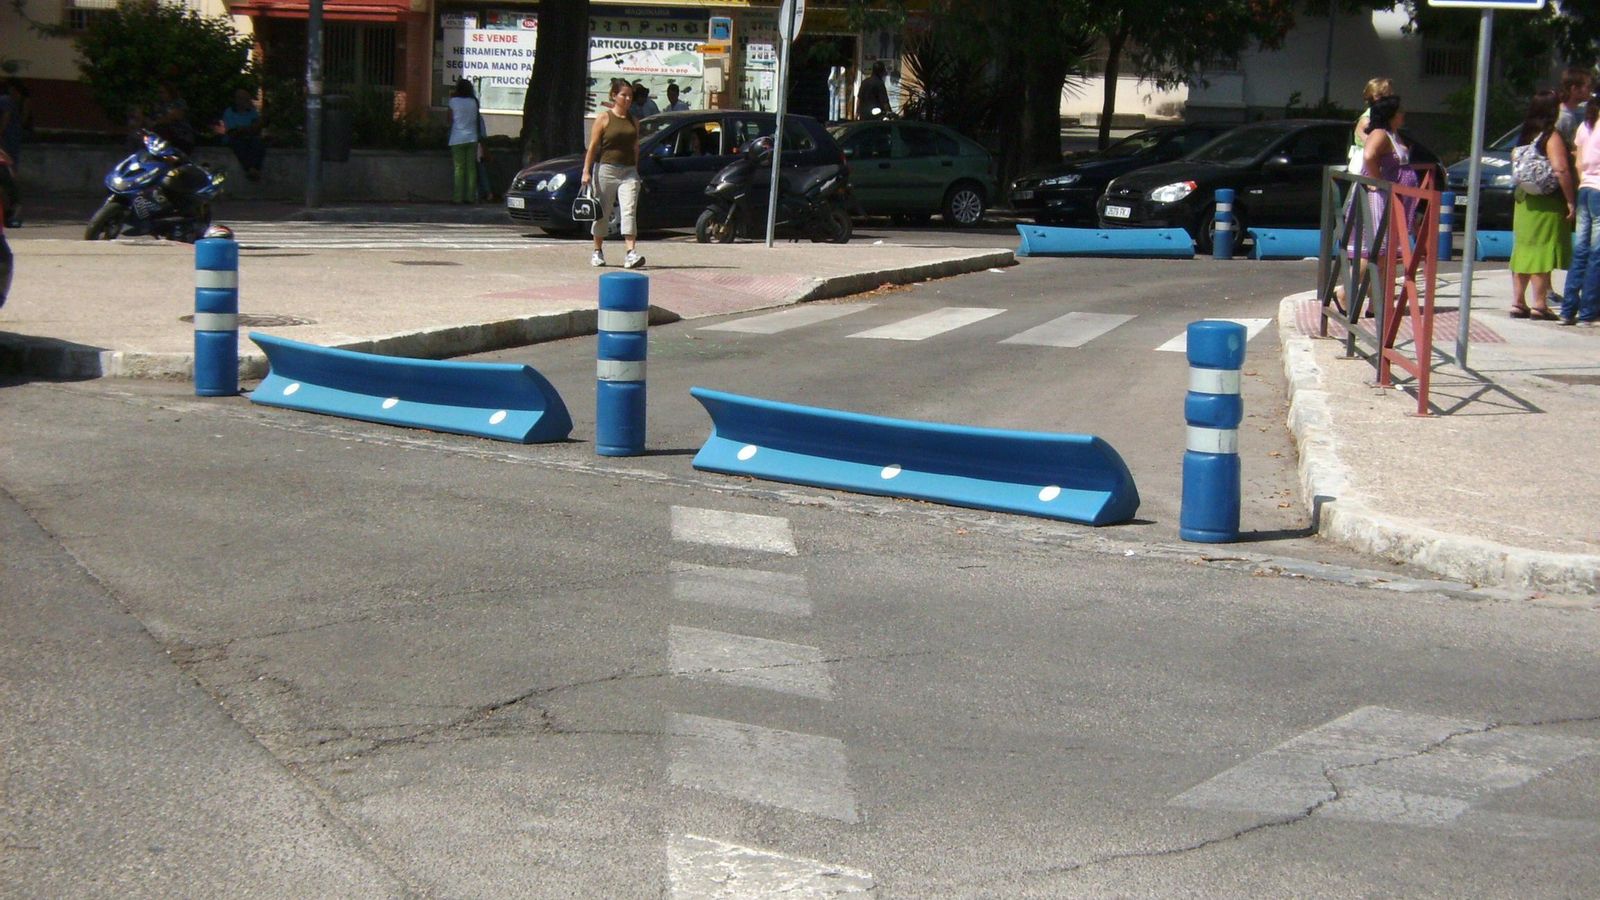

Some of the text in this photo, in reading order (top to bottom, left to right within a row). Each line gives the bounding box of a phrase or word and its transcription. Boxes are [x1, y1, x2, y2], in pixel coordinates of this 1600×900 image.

[472, 34, 518, 43] SE VENDE
[590, 39, 647, 50] ARTICULOS
[651, 41, 664, 50] DE
[668, 42, 699, 51] PESCA
[453, 47, 523, 57] HERRAMIENTAS
[446, 60, 489, 70] SEGUNDA
[492, 62, 518, 70] MANO
